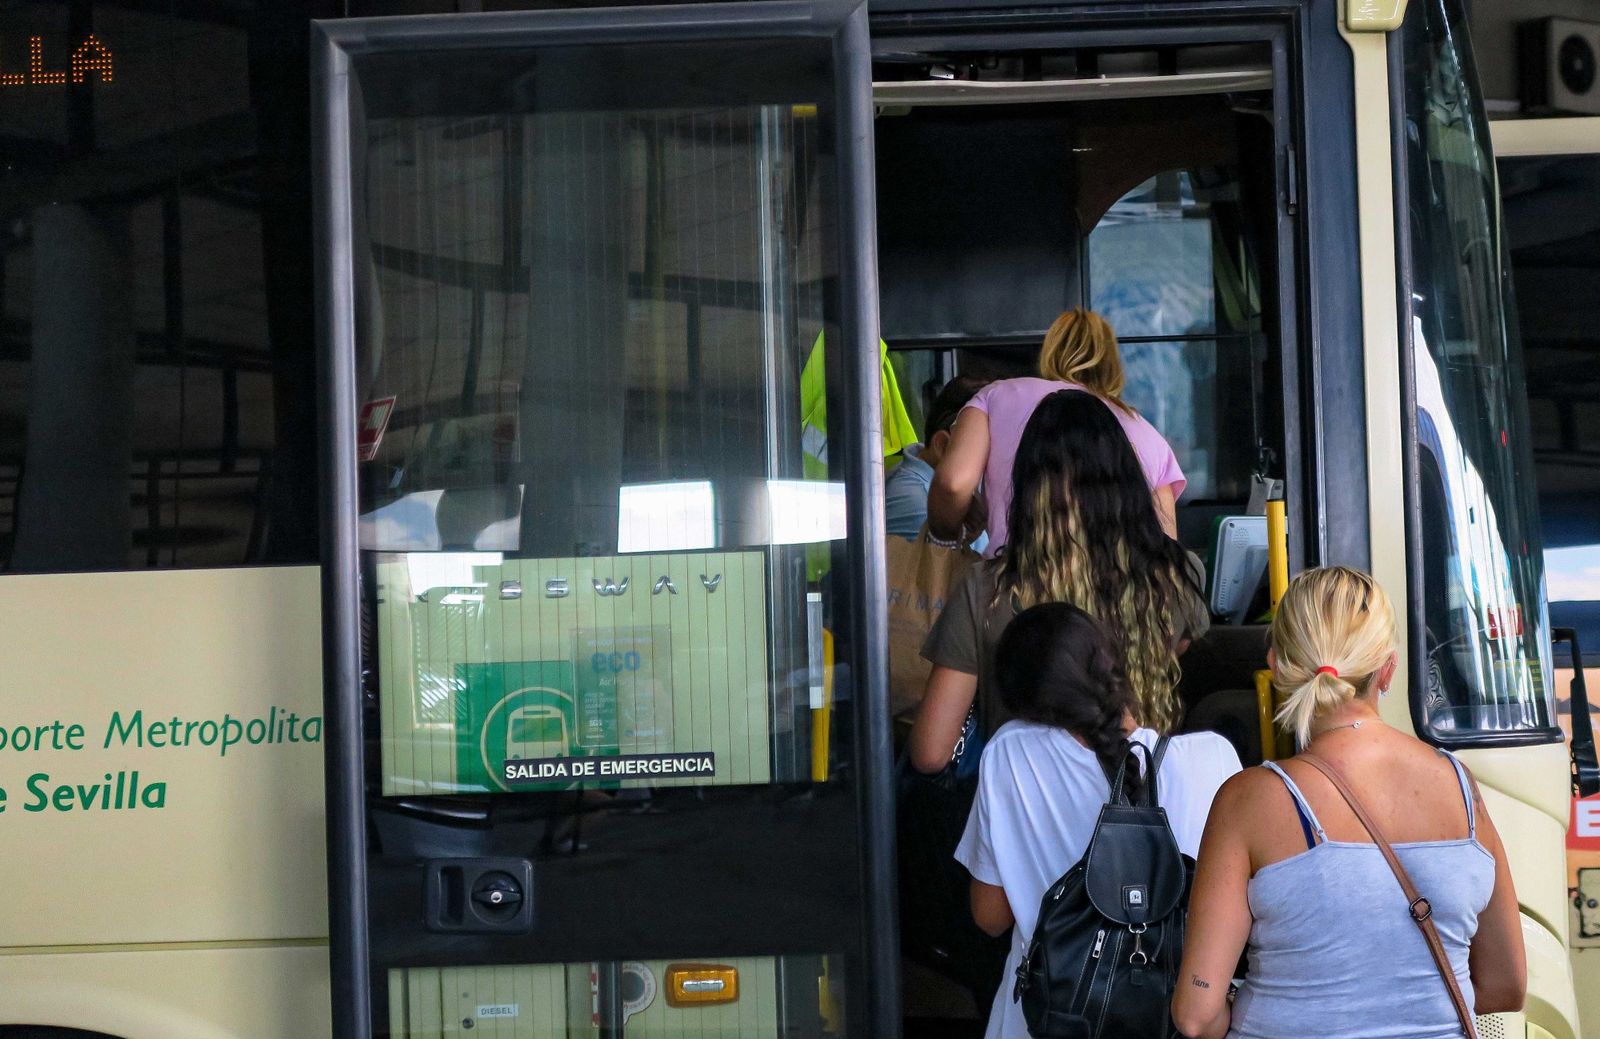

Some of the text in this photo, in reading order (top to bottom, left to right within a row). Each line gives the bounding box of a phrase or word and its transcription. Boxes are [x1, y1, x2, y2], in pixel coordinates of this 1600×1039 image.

[0, 35, 113, 85] LA
[591, 650, 641, 673] eco
[103, 706, 322, 757] Metropolita
[505, 757, 714, 779] SALIDA DE EMERGENCIA
[23, 771, 167, 812] Sevilla
[480, 1007, 513, 1016] DIESEL
